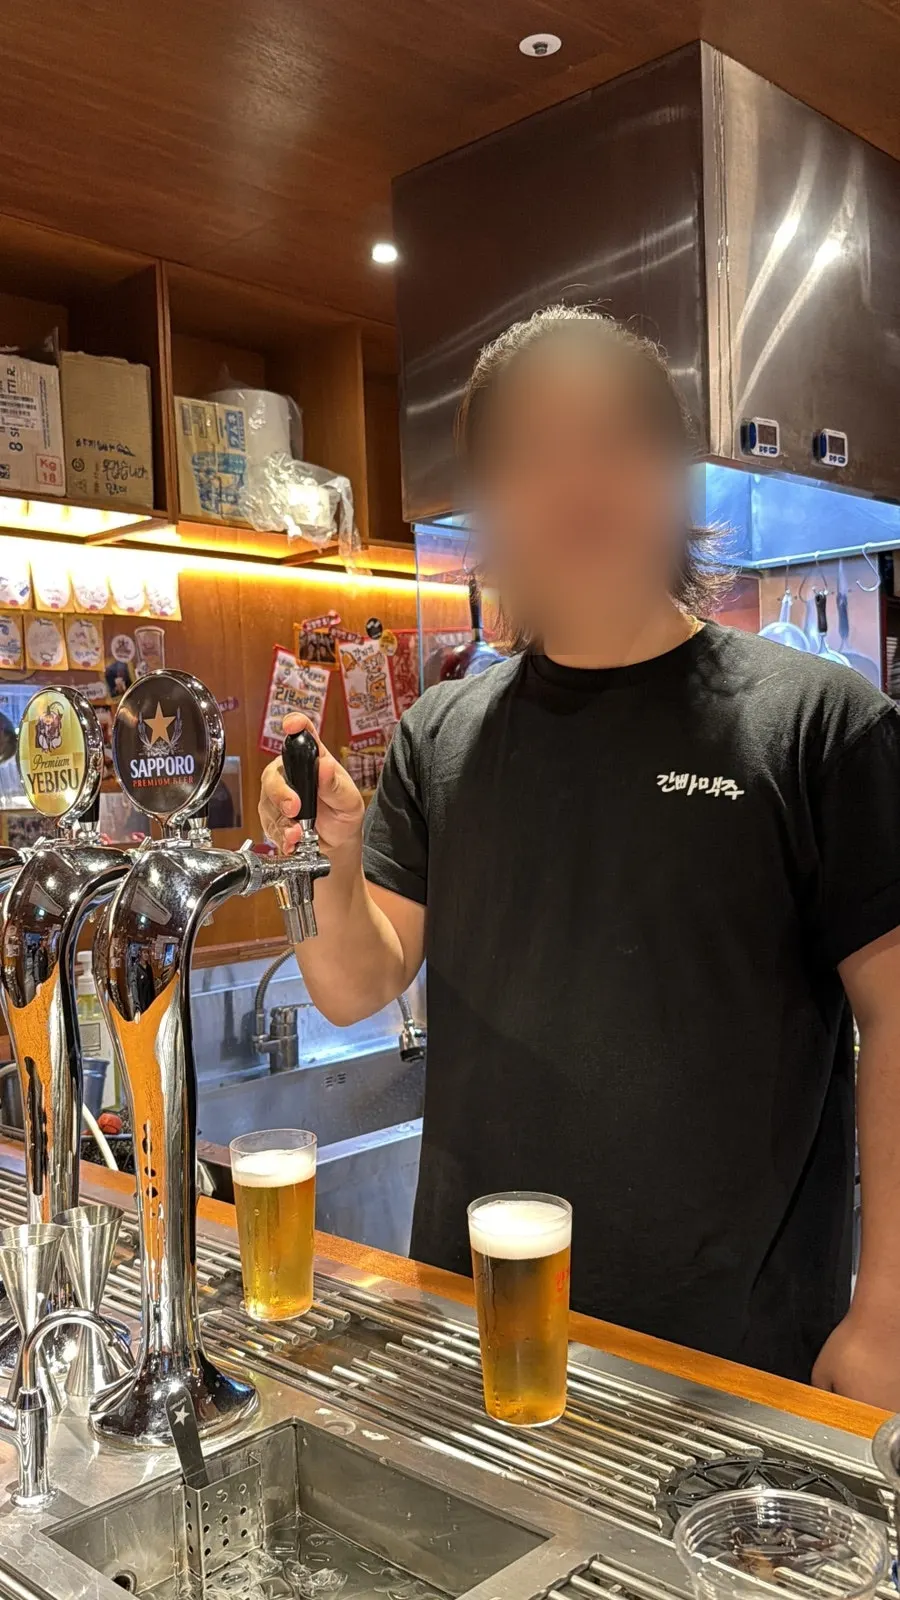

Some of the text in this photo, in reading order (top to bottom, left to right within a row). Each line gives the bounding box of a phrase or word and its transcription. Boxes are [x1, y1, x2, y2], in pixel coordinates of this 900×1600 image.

[40, 459, 57, 471] Kg
[32, 754, 70, 771] Premium
[130, 754, 195, 779] SAPPORO
[27, 768, 79, 794] YEBISU
[132, 775, 194, 788] PREMIUM BEER
[656, 771, 745, 800] 간빠맥주
